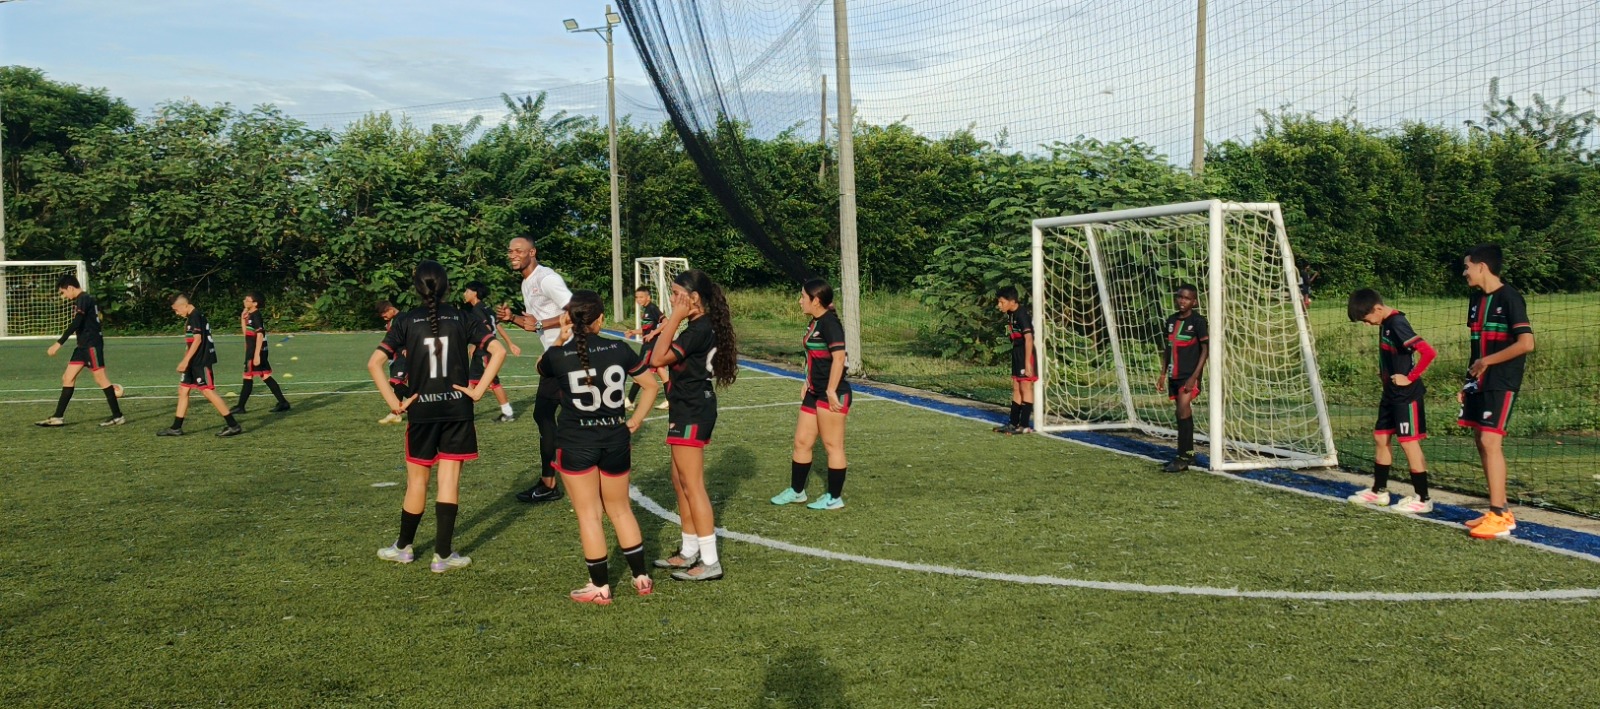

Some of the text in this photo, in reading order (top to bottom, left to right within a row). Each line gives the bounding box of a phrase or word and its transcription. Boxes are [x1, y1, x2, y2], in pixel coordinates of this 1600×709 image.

[423, 336, 449, 379] 11
[417, 390, 463, 403] AMISTAD
[567, 364, 626, 412] 58
[1400, 422, 1410, 434] 17
